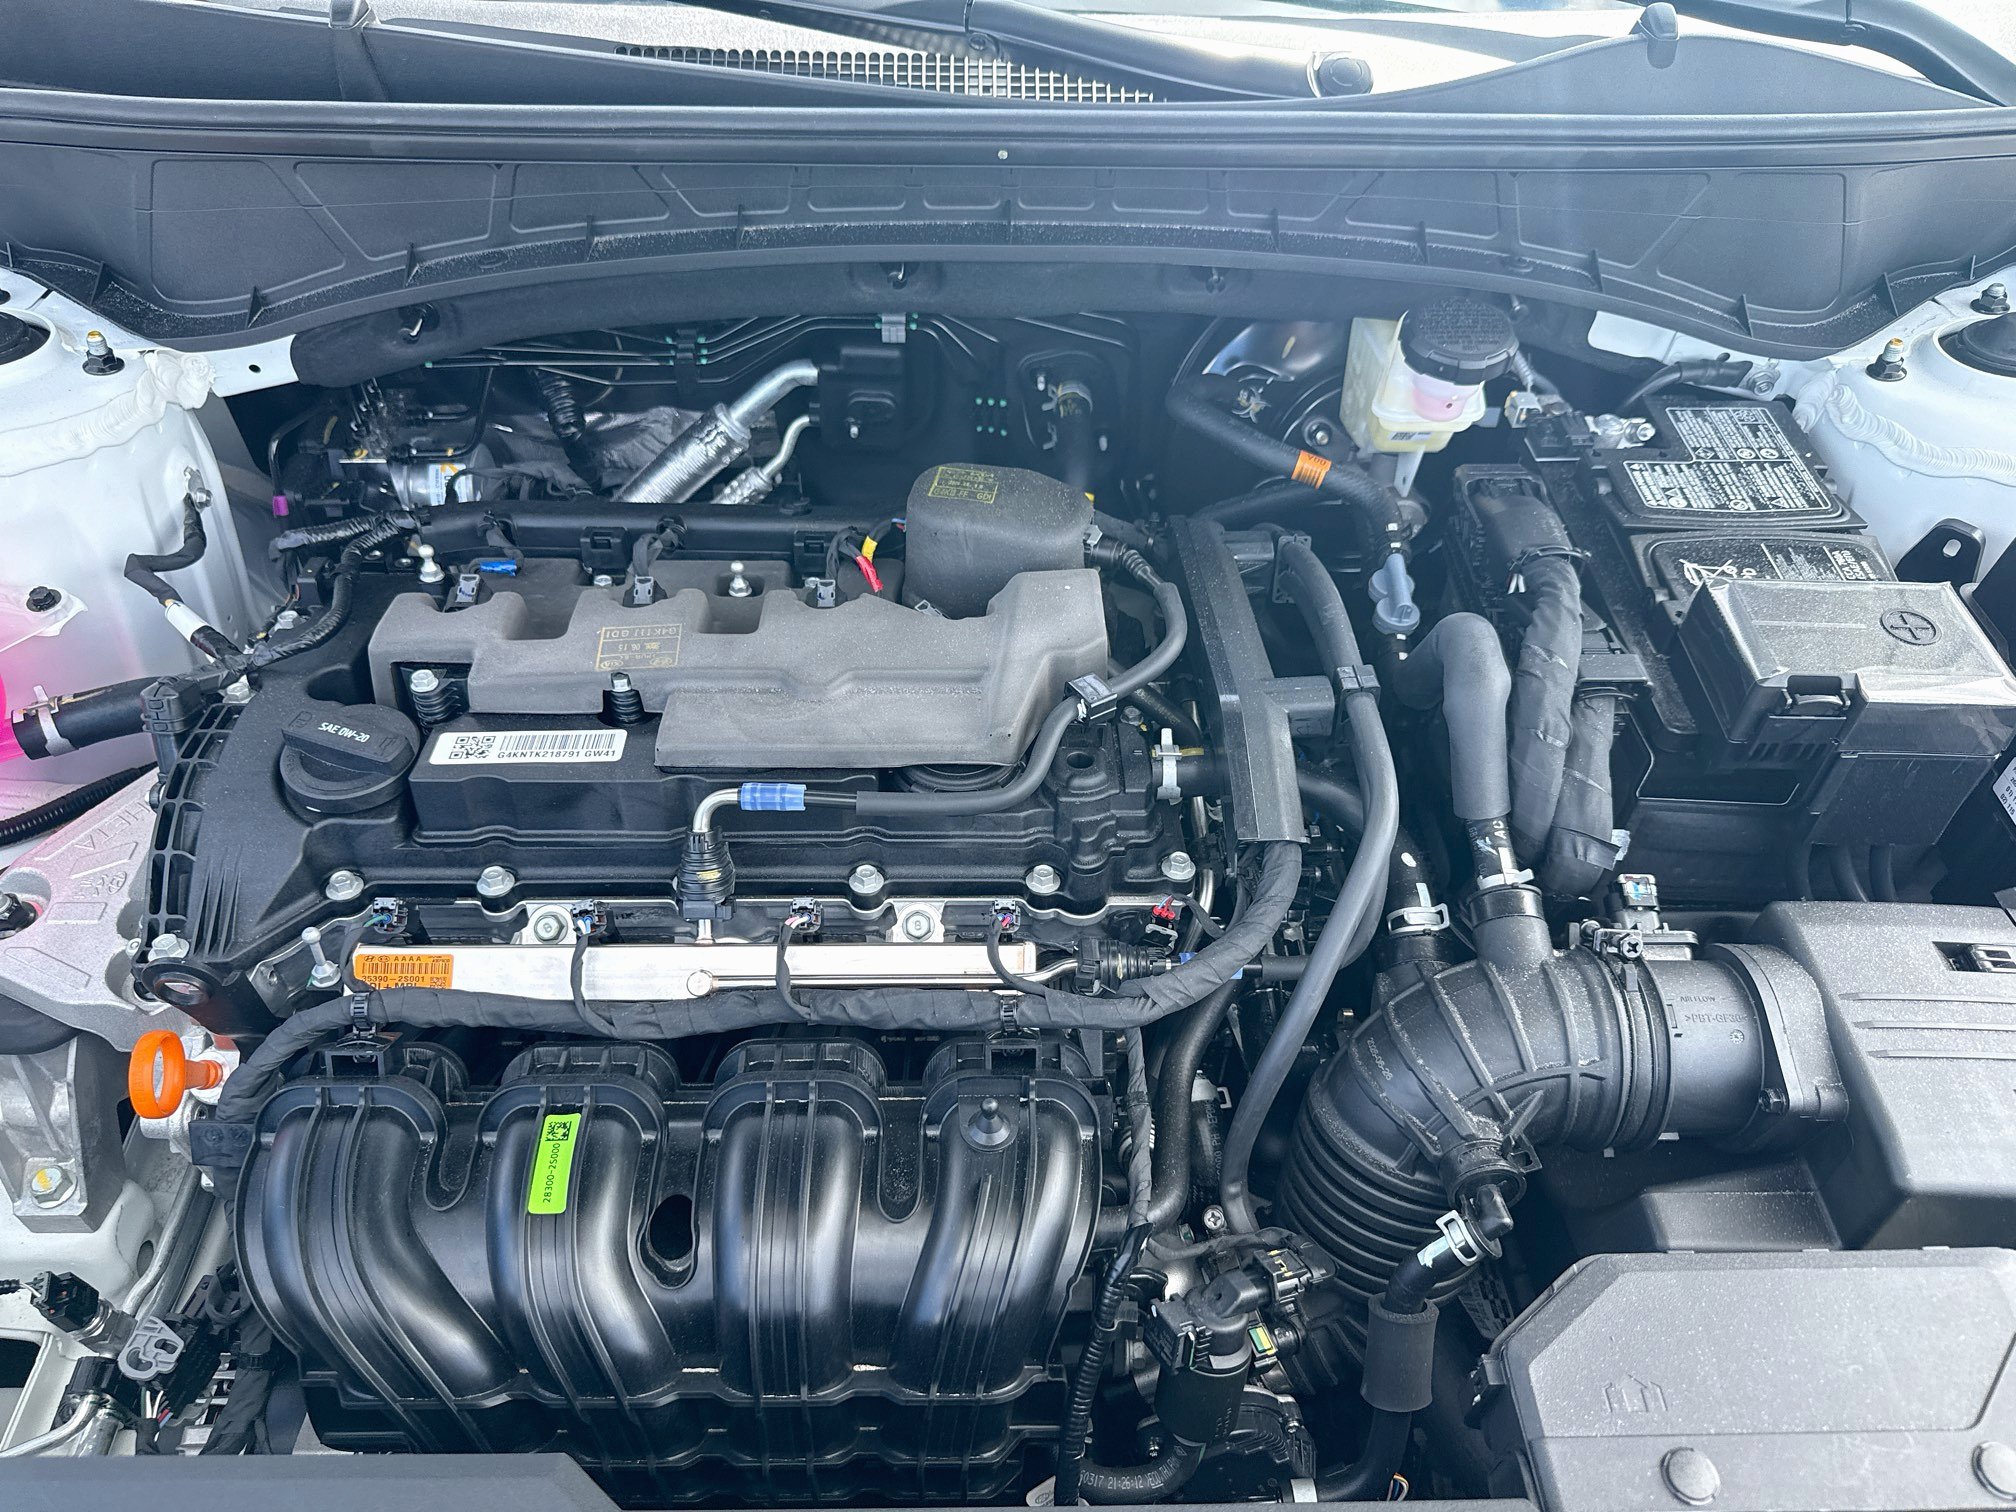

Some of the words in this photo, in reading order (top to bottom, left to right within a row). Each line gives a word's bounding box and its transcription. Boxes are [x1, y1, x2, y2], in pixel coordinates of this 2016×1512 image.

[318, 722, 338, 734] SAE
[338, 727, 371, 743] 0W-20
[497, 750, 580, 759] G4KNTK218791
[543, 1142, 561, 1203] 28300-2S000
[1107, 1475, 1144, 1490] 21:26:12
